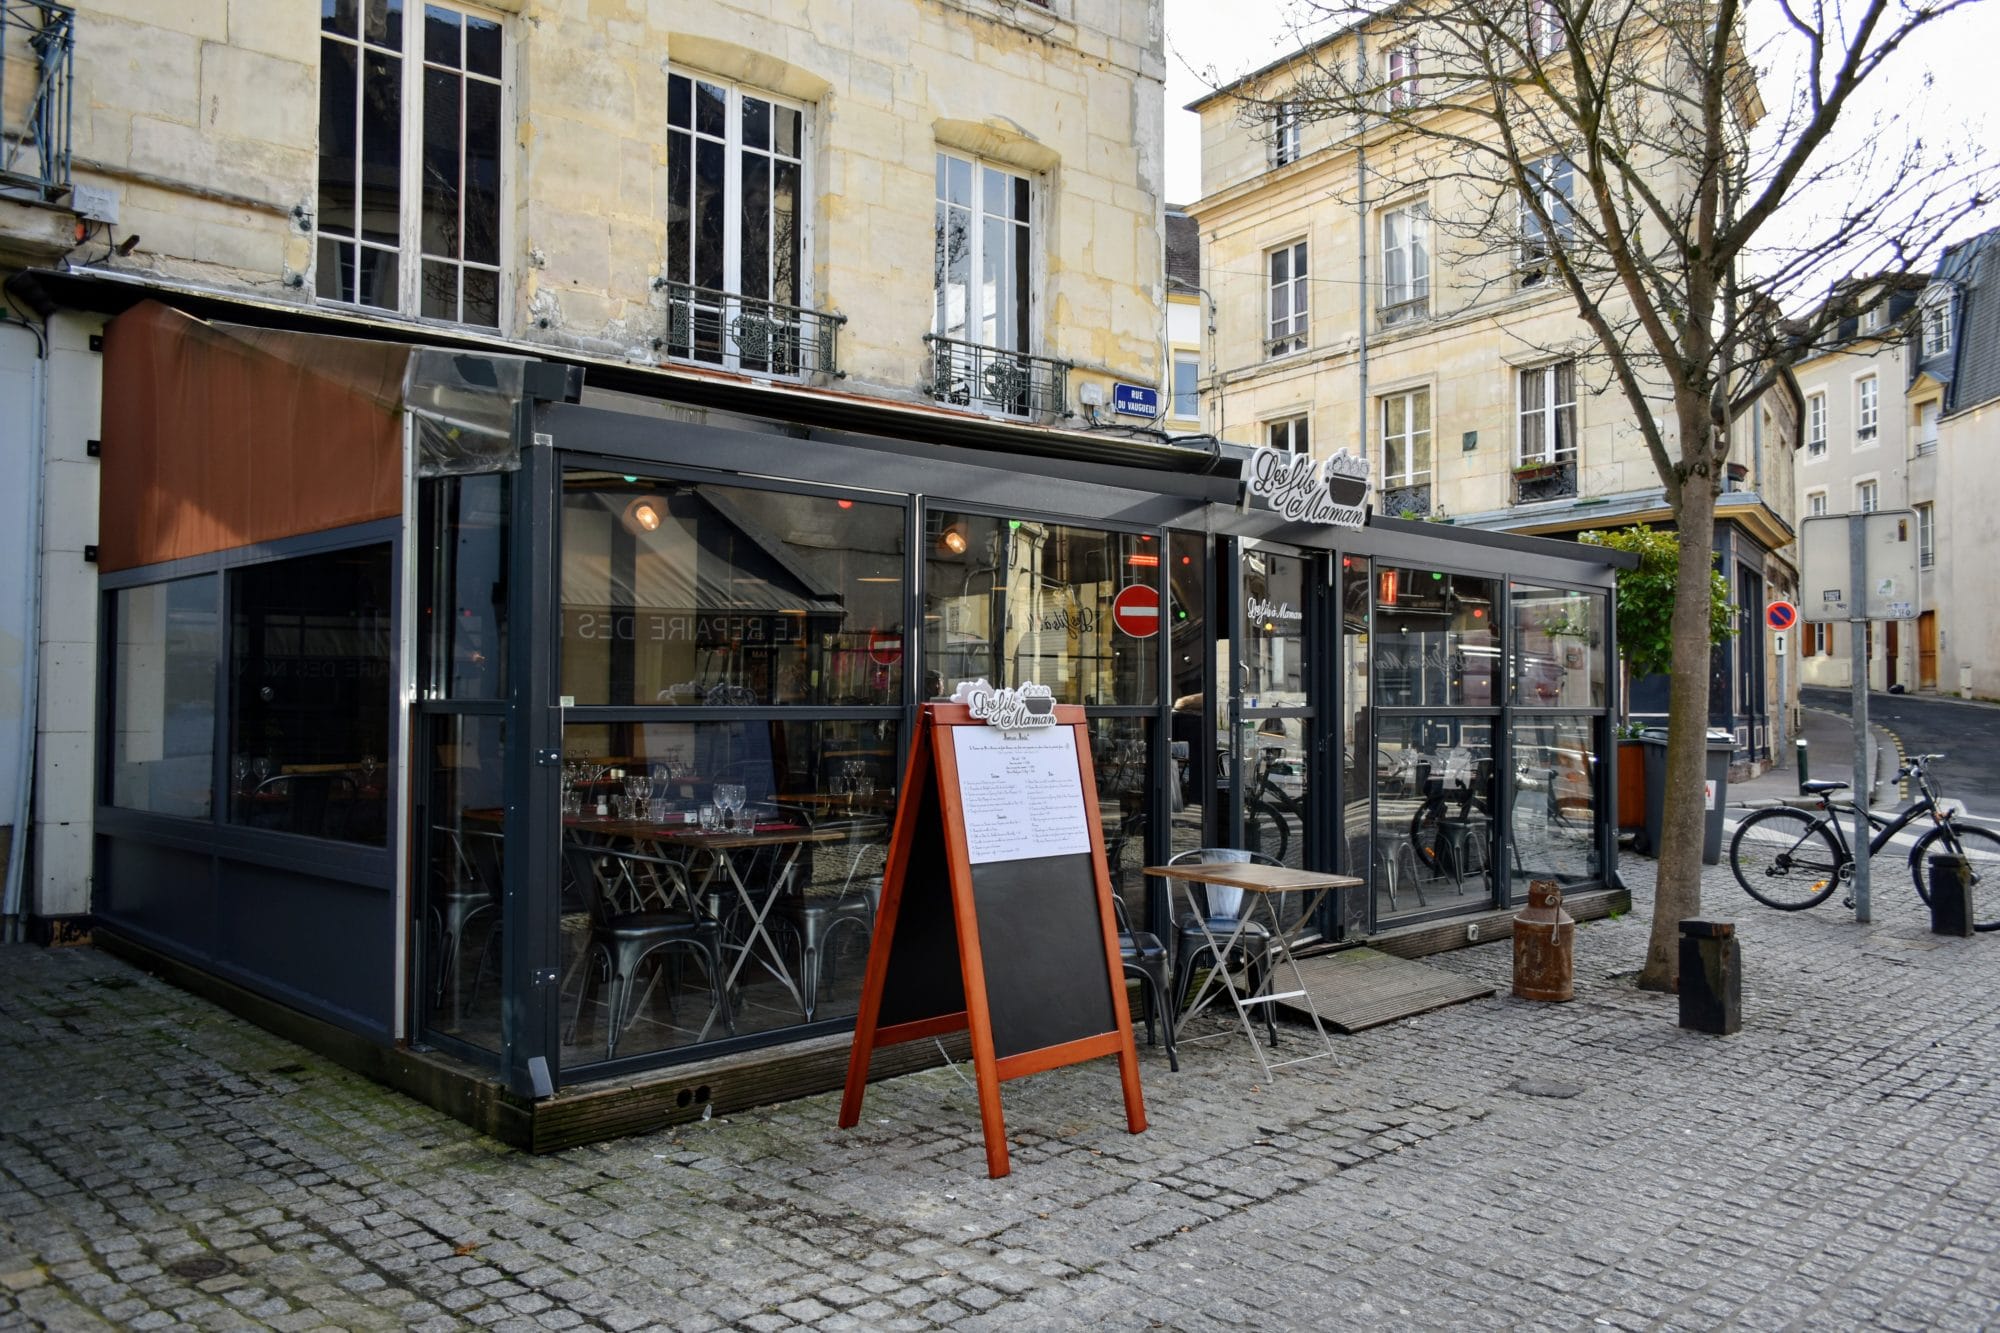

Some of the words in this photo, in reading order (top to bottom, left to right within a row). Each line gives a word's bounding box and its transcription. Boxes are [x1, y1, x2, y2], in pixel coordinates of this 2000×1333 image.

[1131, 390, 1144, 400] RUE
[1118, 400, 1126, 409] DU
[1128, 401, 1156, 414] VAUGUEUX
[1253, 451, 1290, 493] Les
[1275, 454, 1318, 507] fils
[1301, 488, 1364, 525] Maman
[1247, 597, 1261, 619] Les
[1277, 602, 1302, 620] Maman
[973, 691, 997, 717] Les
[991, 692, 1016, 722] fils
[1011, 707, 1056, 726] Maman
